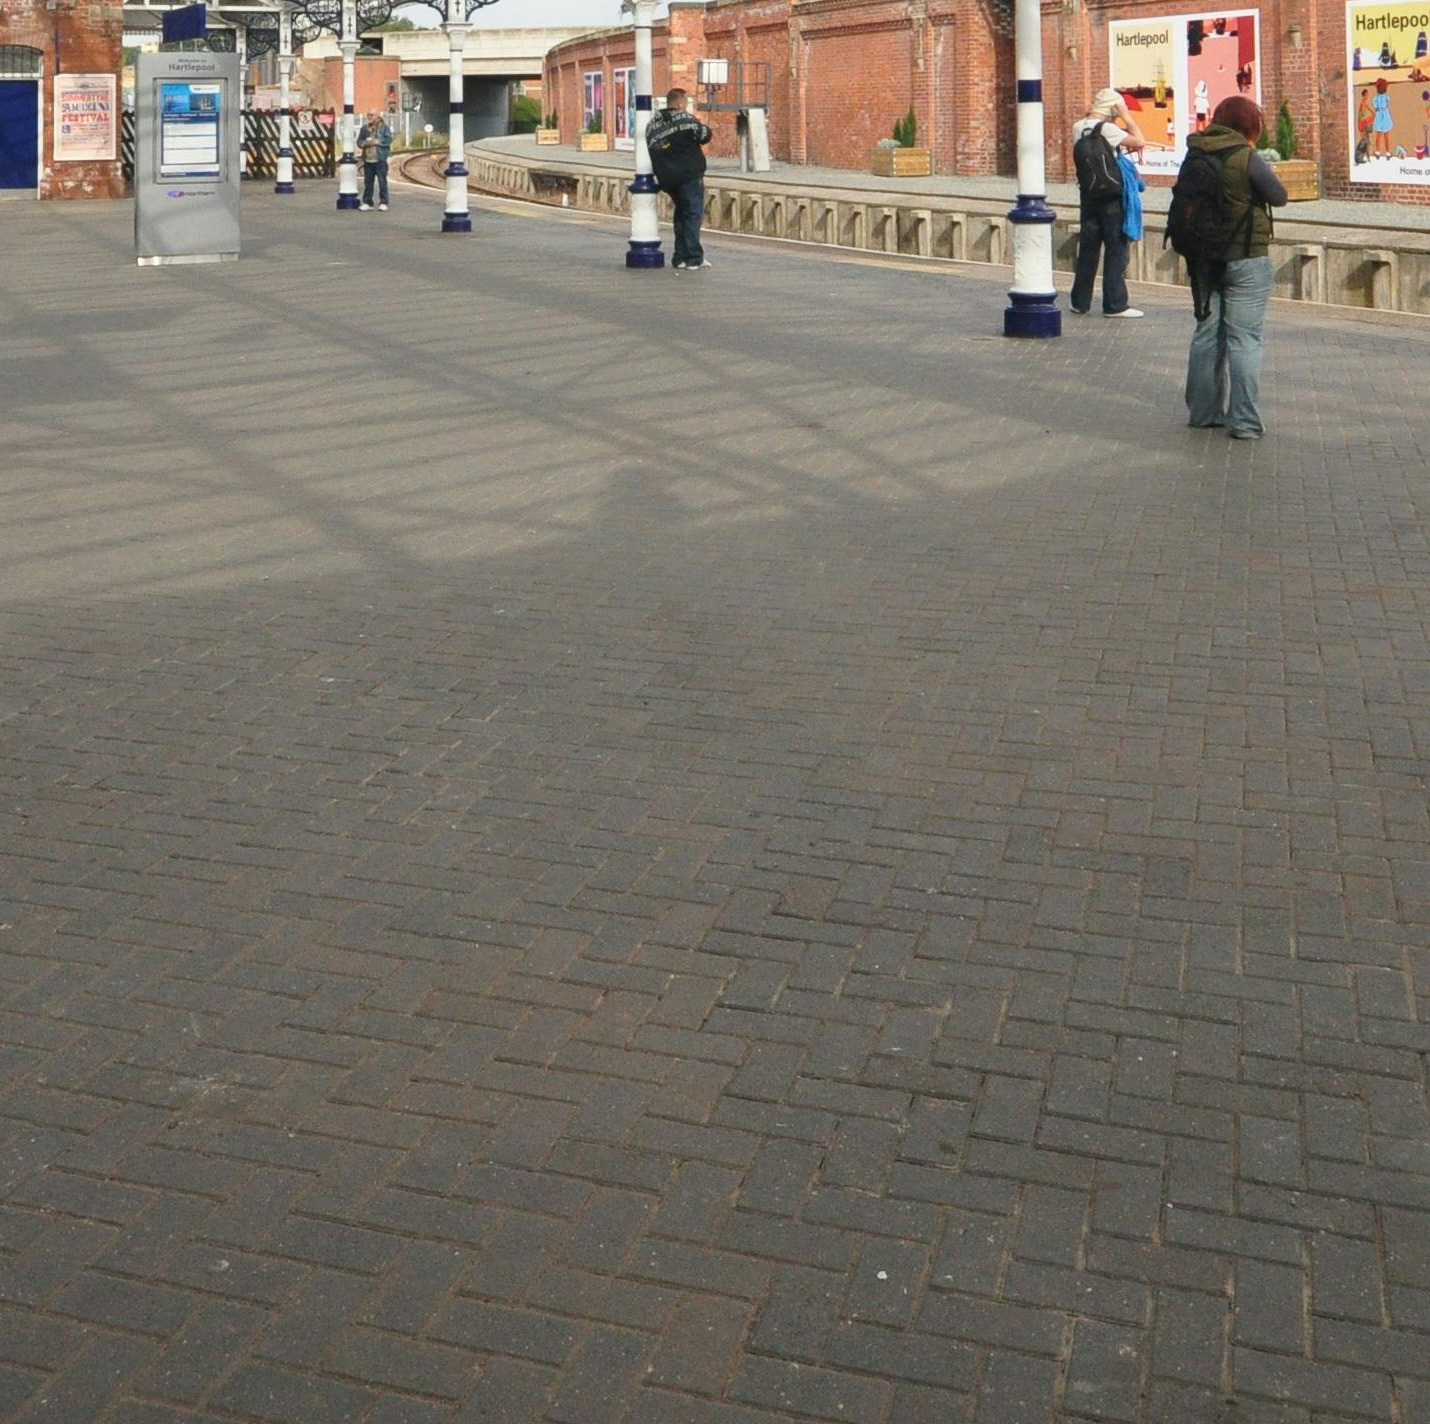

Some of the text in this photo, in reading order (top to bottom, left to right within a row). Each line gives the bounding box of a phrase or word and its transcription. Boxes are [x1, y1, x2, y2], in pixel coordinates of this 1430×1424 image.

[1116, 29, 1169, 48] Hartlepool
[169, 64, 215, 72] Hartlepool
[62, 113, 109, 122] FESTIVAL
[1400, 167, 1422, 176] Home
